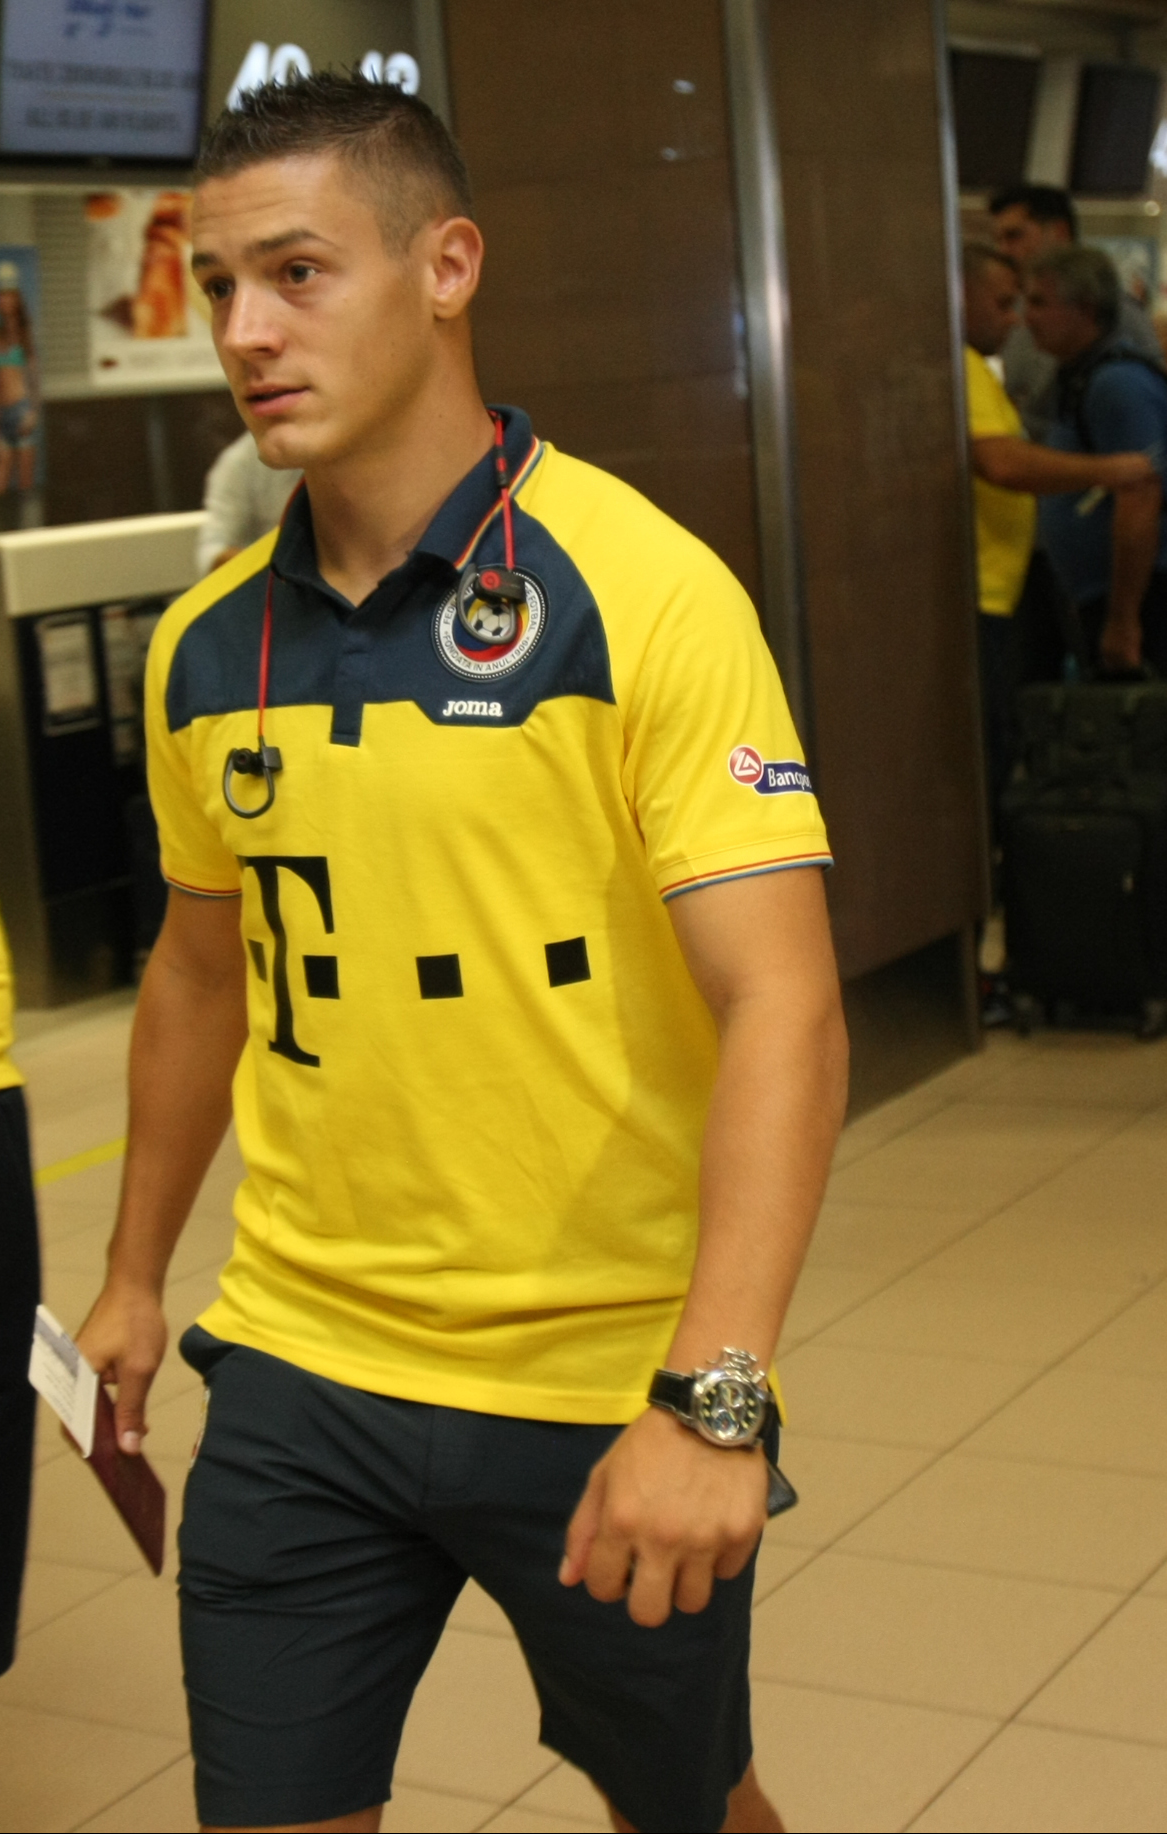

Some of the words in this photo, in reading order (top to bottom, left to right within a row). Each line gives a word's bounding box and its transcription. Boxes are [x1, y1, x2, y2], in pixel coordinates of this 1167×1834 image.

[442, 633, 472, 669] FONDATA
[472, 663, 484, 673] IN
[484, 657, 513, 672] ANUL
[510, 640, 530, 661] 1909
